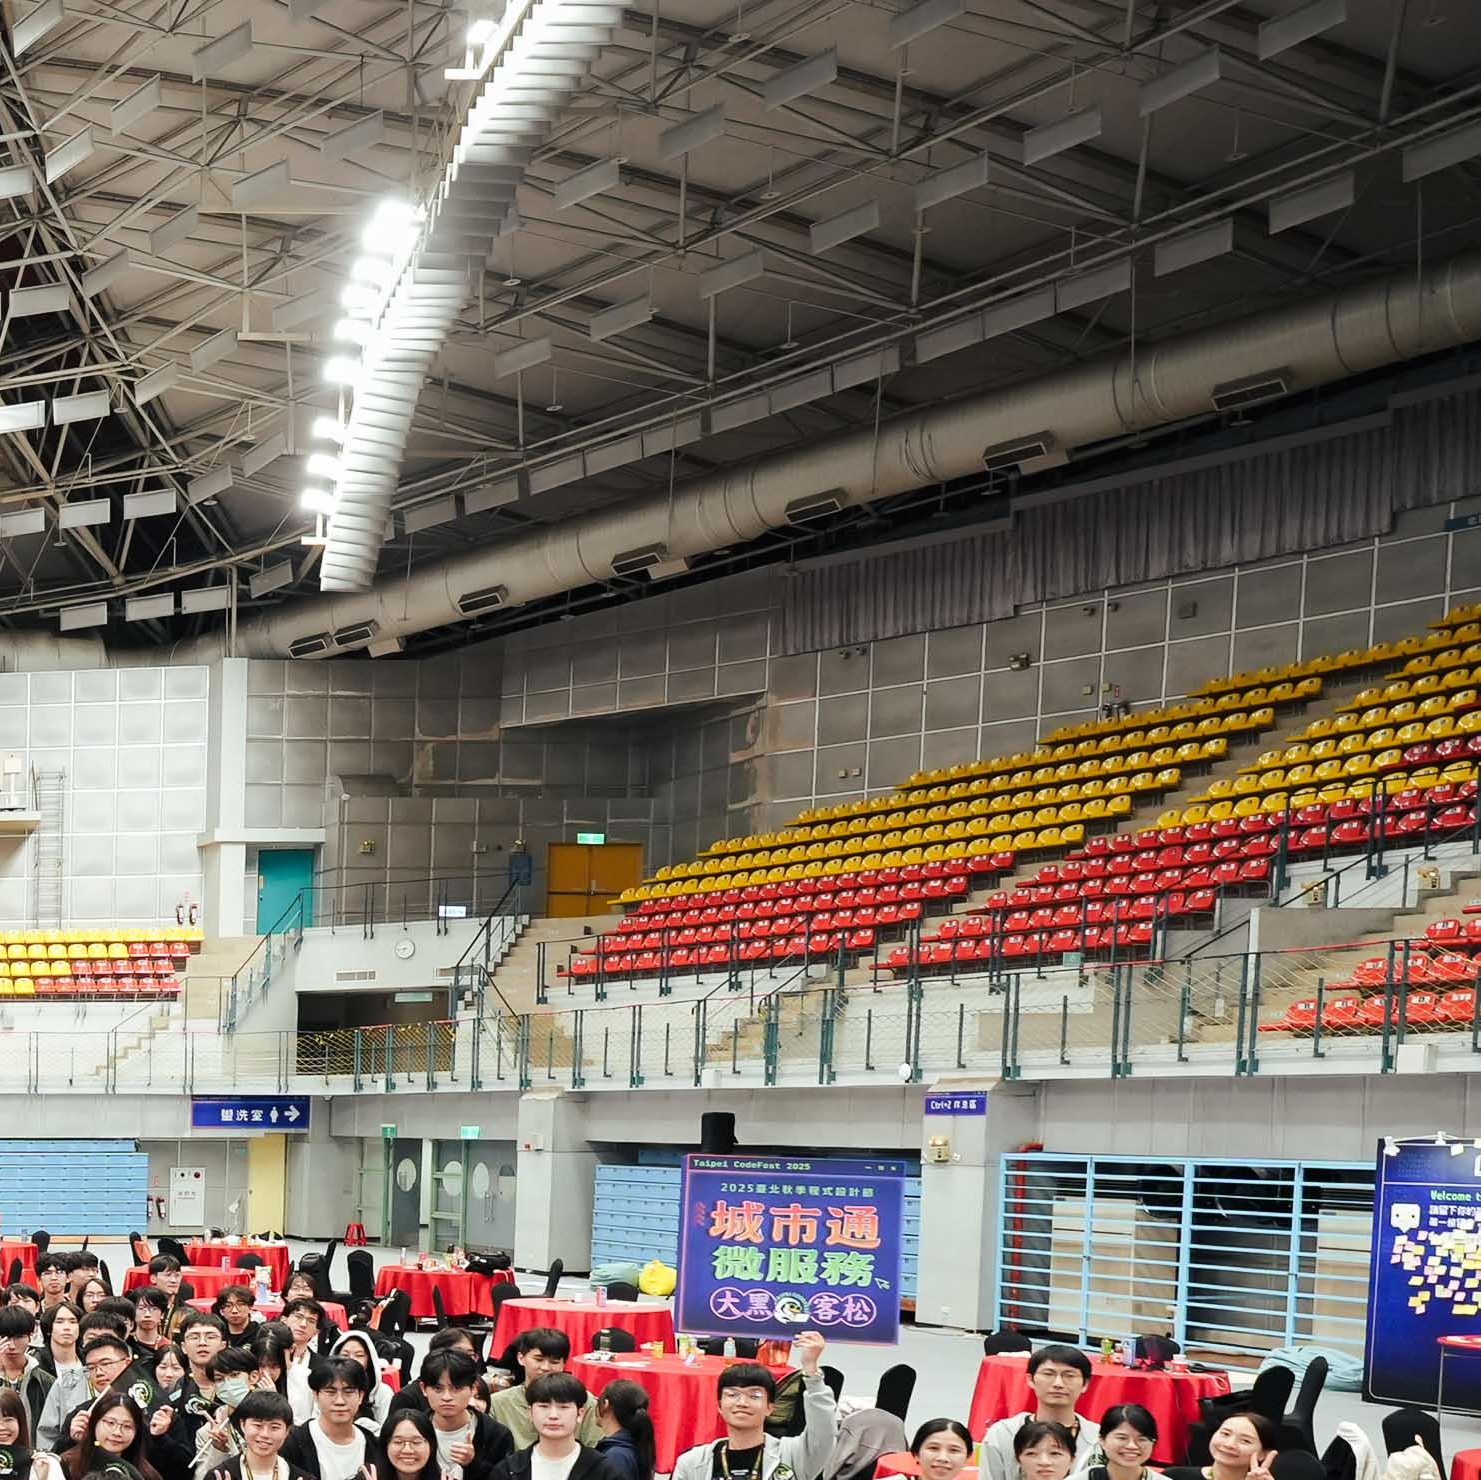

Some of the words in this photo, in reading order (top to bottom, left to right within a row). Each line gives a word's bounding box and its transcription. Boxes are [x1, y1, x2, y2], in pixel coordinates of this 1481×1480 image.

[221, 1108, 264, 1122] 盥洗室
[693, 1159, 728, 1169] Taipei
[733, 1160, 781, 1170] CodeFest
[786, 1162, 811, 1171] 2025
[1430, 1190, 1472, 1201] Welcome
[709, 1200, 881, 1249] 城市通
[712, 1245, 876, 1287] 微服務
